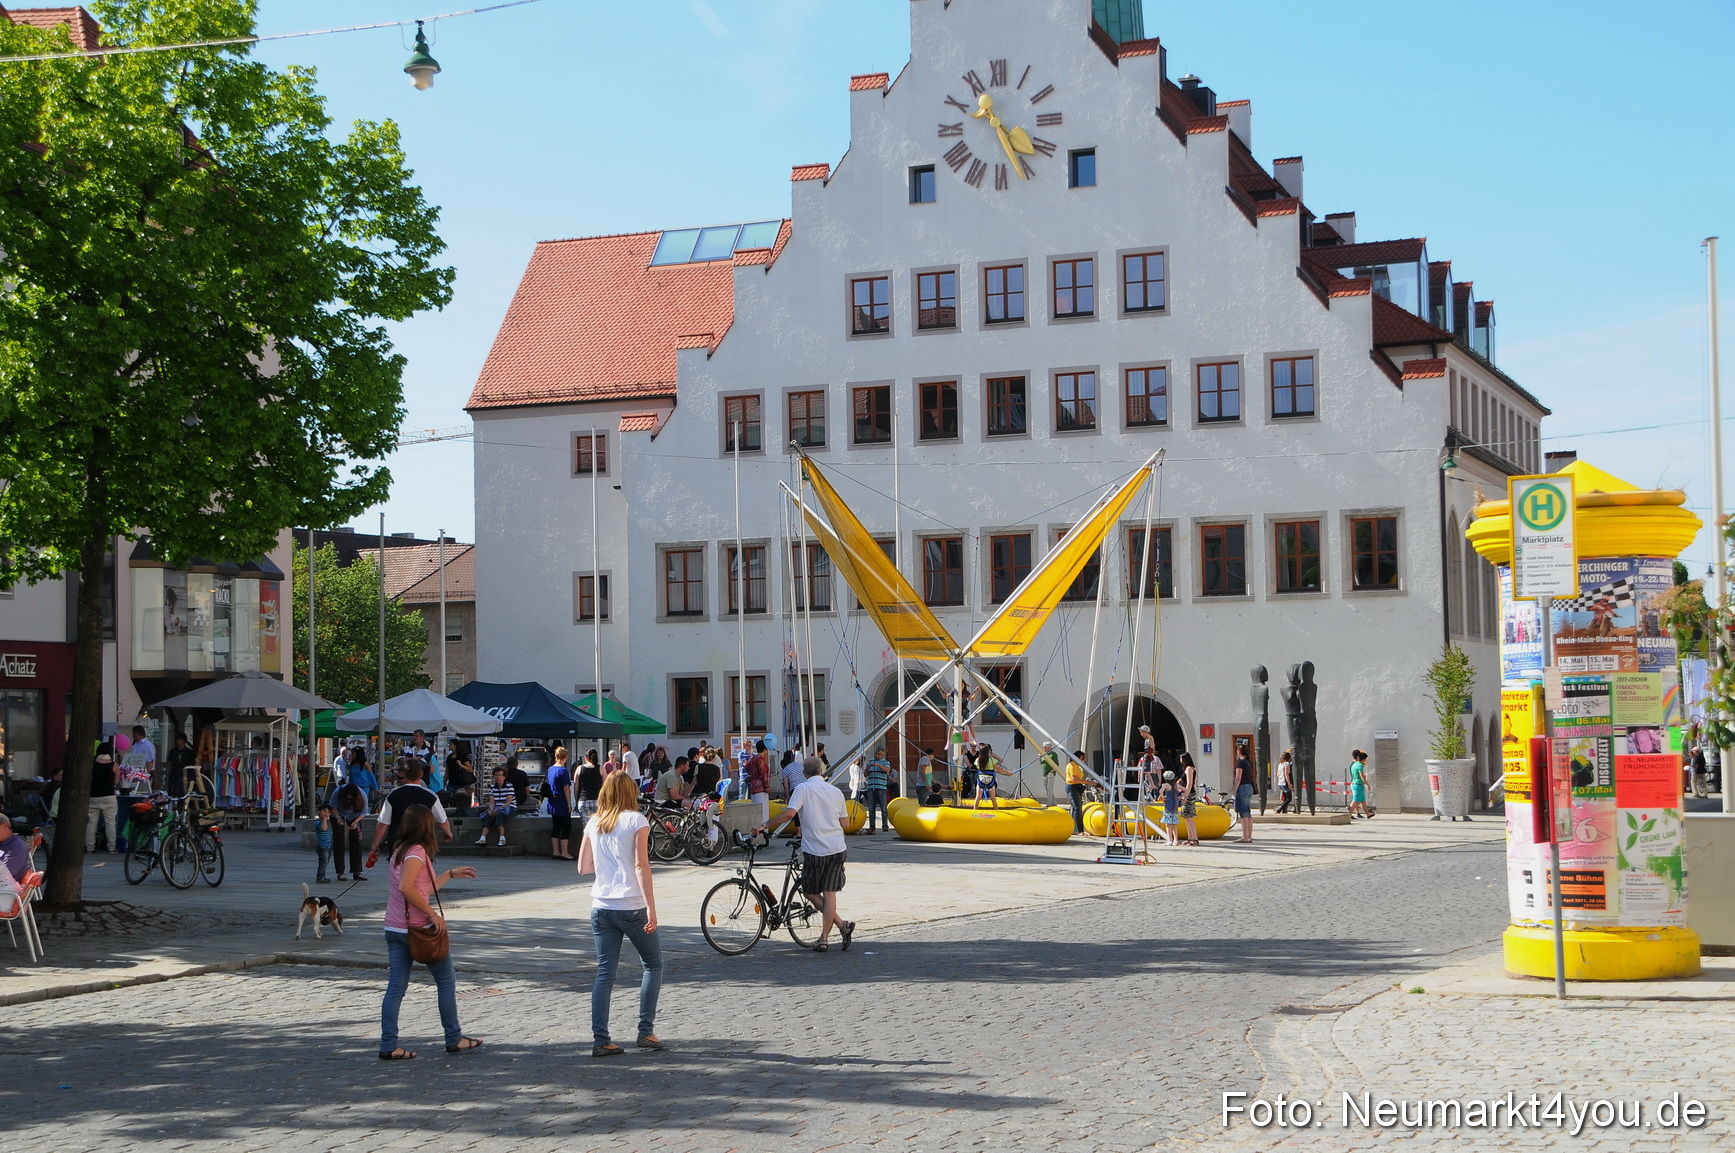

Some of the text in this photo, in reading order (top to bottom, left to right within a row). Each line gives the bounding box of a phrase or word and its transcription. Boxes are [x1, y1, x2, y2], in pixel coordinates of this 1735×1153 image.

[990, 59, 1007, 87] XII
[1530, 494, 1554, 521] H
[1522, 536, 1564, 545] Marktplatz
[1578, 562, 1629, 573] ERCHINGER
[1580, 574, 1611, 584] MOTO-
[1555, 634, 1634, 645] Rhein-Main-Donau-Ring
[0, 653, 37, 677] Achatz
[1578, 683, 1609, 691] Festival
[1598, 738, 1610, 786] DISCOZELT
[1575, 873, 1603, 882] Bühne
